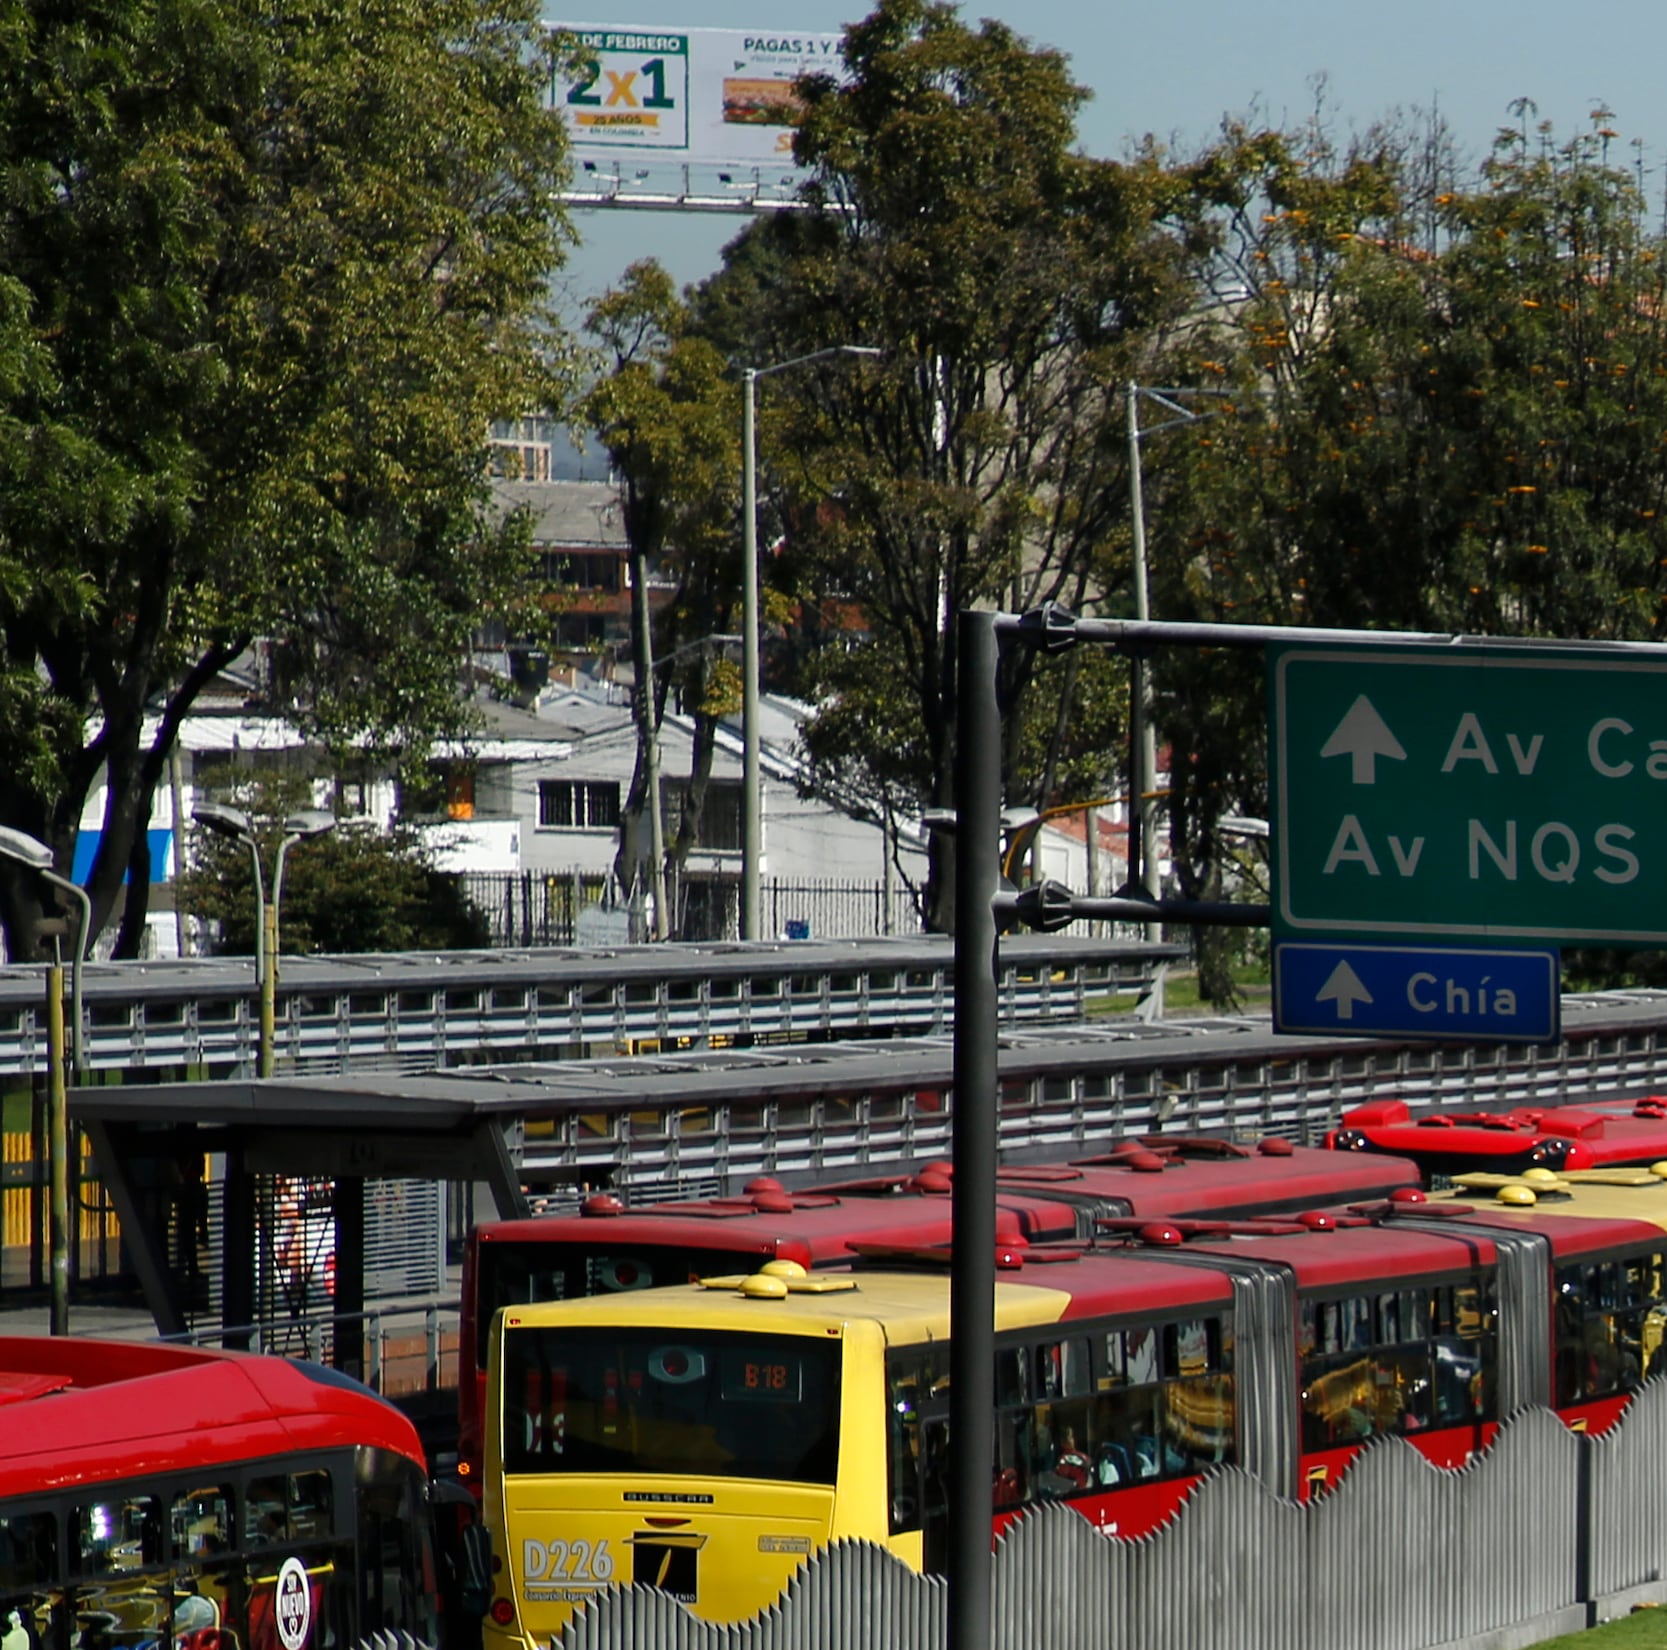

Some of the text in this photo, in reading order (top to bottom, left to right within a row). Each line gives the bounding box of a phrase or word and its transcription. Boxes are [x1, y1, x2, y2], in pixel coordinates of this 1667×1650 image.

[582, 34, 603, 48] DE
[606, 35, 680, 51] FEBRERO
[744, 38, 802, 53] PAGAS
[807, 41, 815, 54] 1
[820, 41, 831, 54] Y
[566, 58, 675, 109] 2x1
[1441, 712, 1545, 775] Av
[1322, 814, 1640, 884] Av NQS
[1406, 971, 1518, 1018] Chía
[523, 1538, 613, 1580] D226
